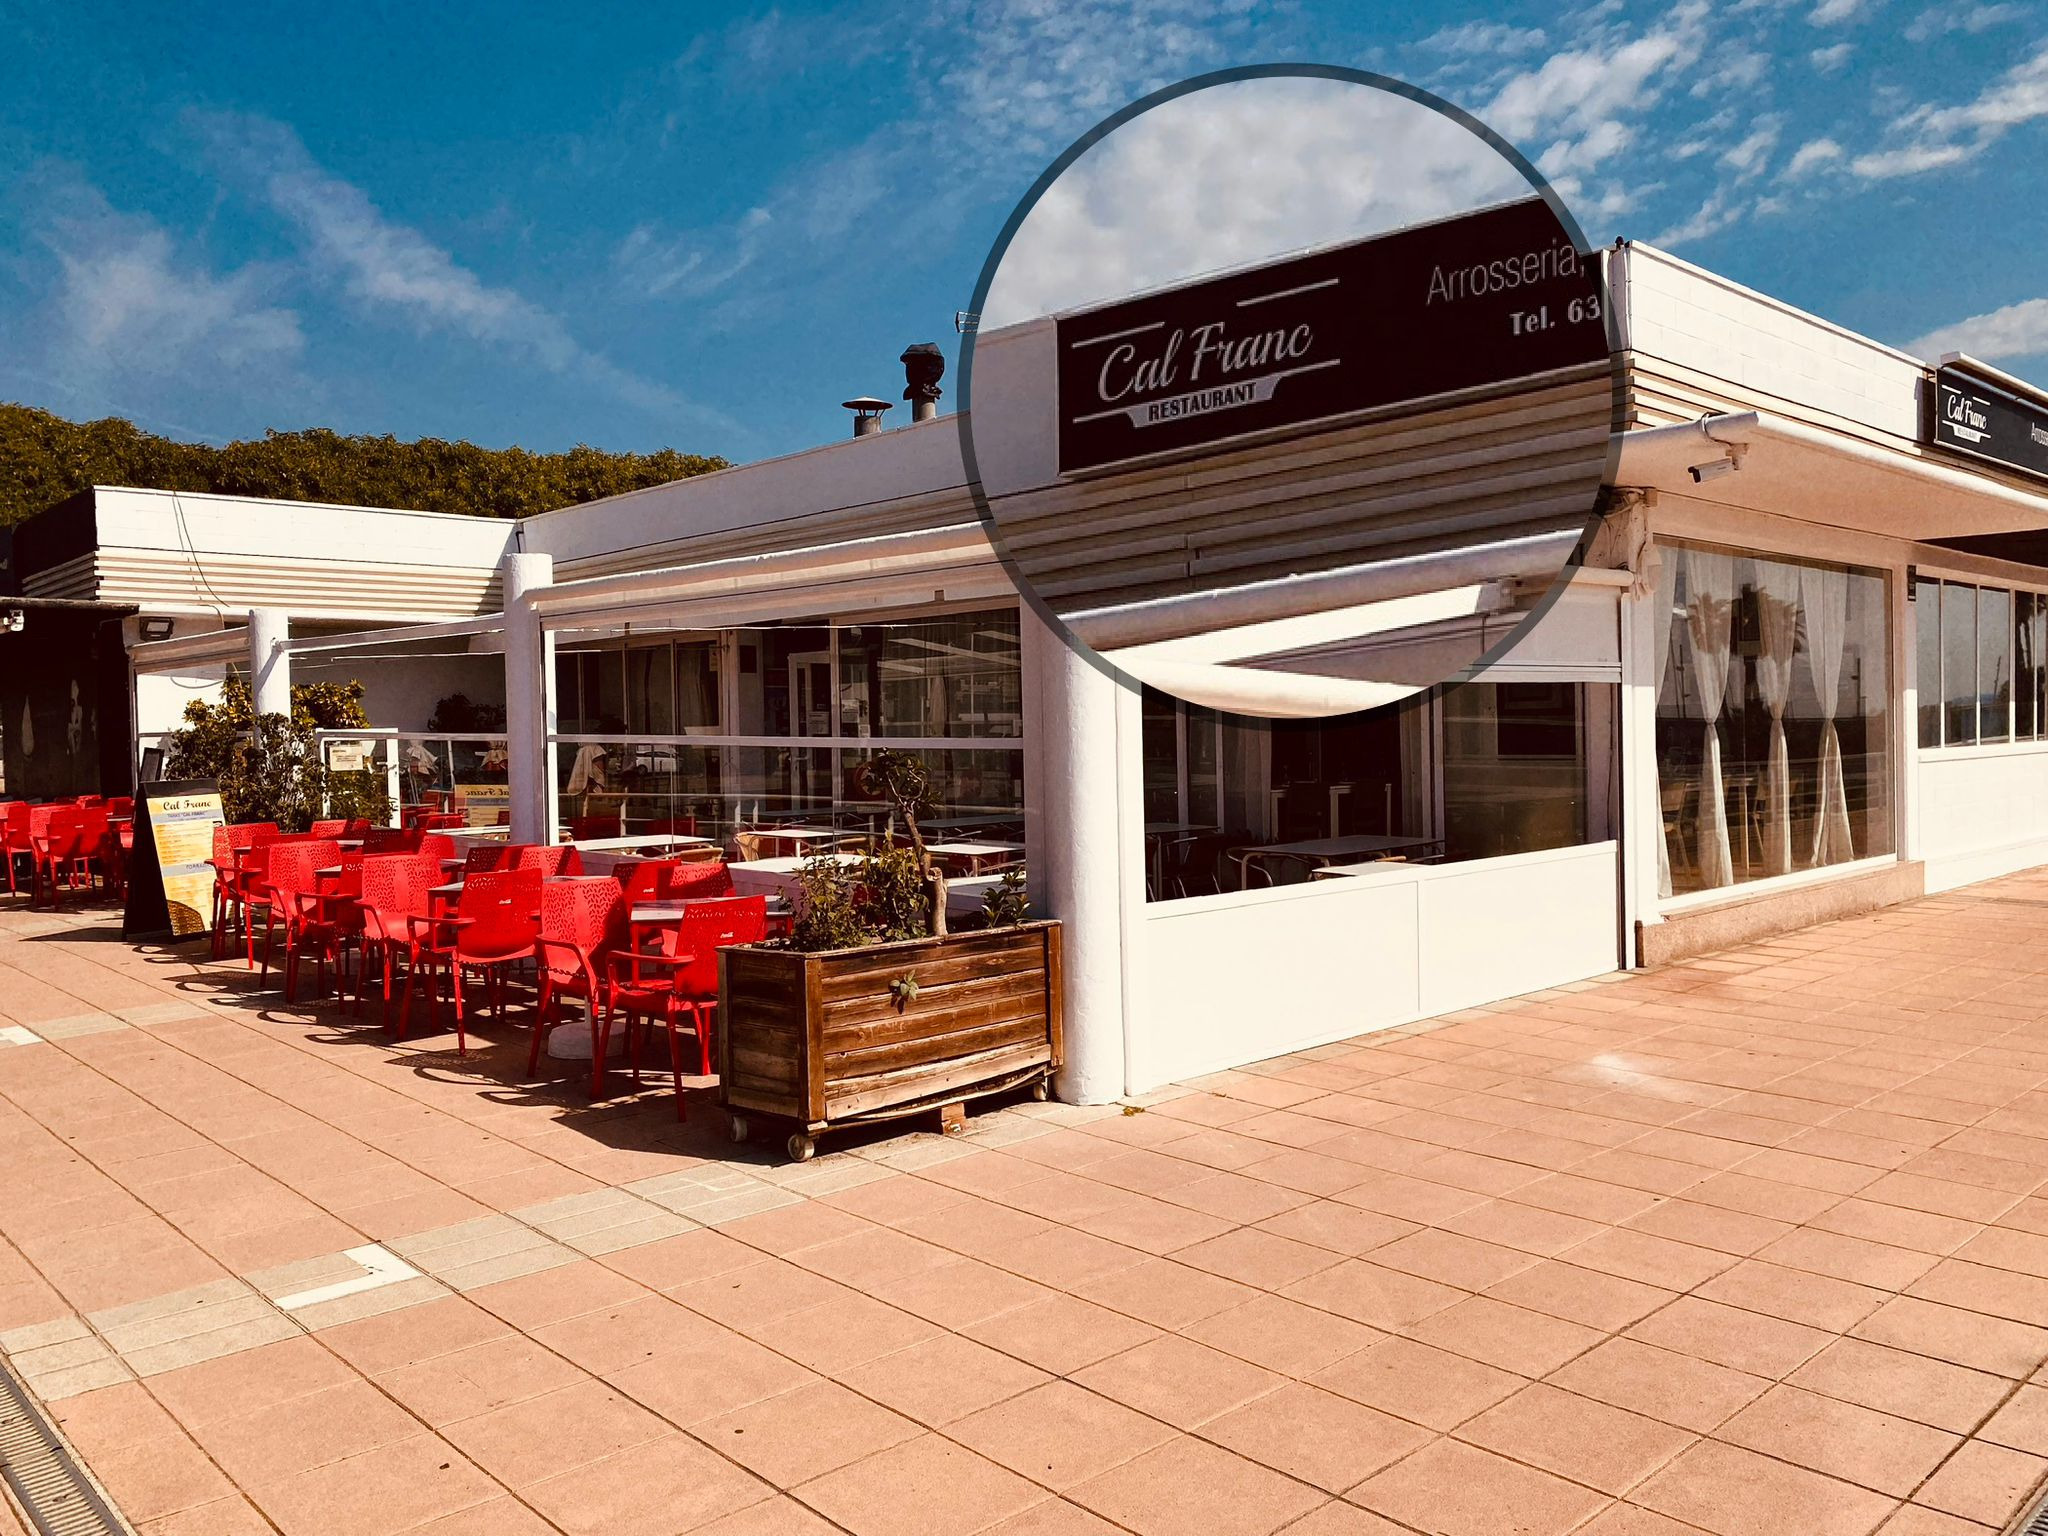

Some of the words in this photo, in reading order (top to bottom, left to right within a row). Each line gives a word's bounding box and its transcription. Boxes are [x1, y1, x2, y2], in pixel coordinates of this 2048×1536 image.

[1509, 305, 1555, 336] Tel.
[1567, 294, 1601, 323] 63
[1098, 328, 1184, 401] Cal
[1190, 321, 1314, 383] Franc
[1149, 381, 1258, 423] RESTAURANT
[1948, 395, 1964, 422] Cal
[1965, 400, 1987, 430] Franc
[163, 800, 180, 811] Cal
[184, 799, 211, 809] Franc
